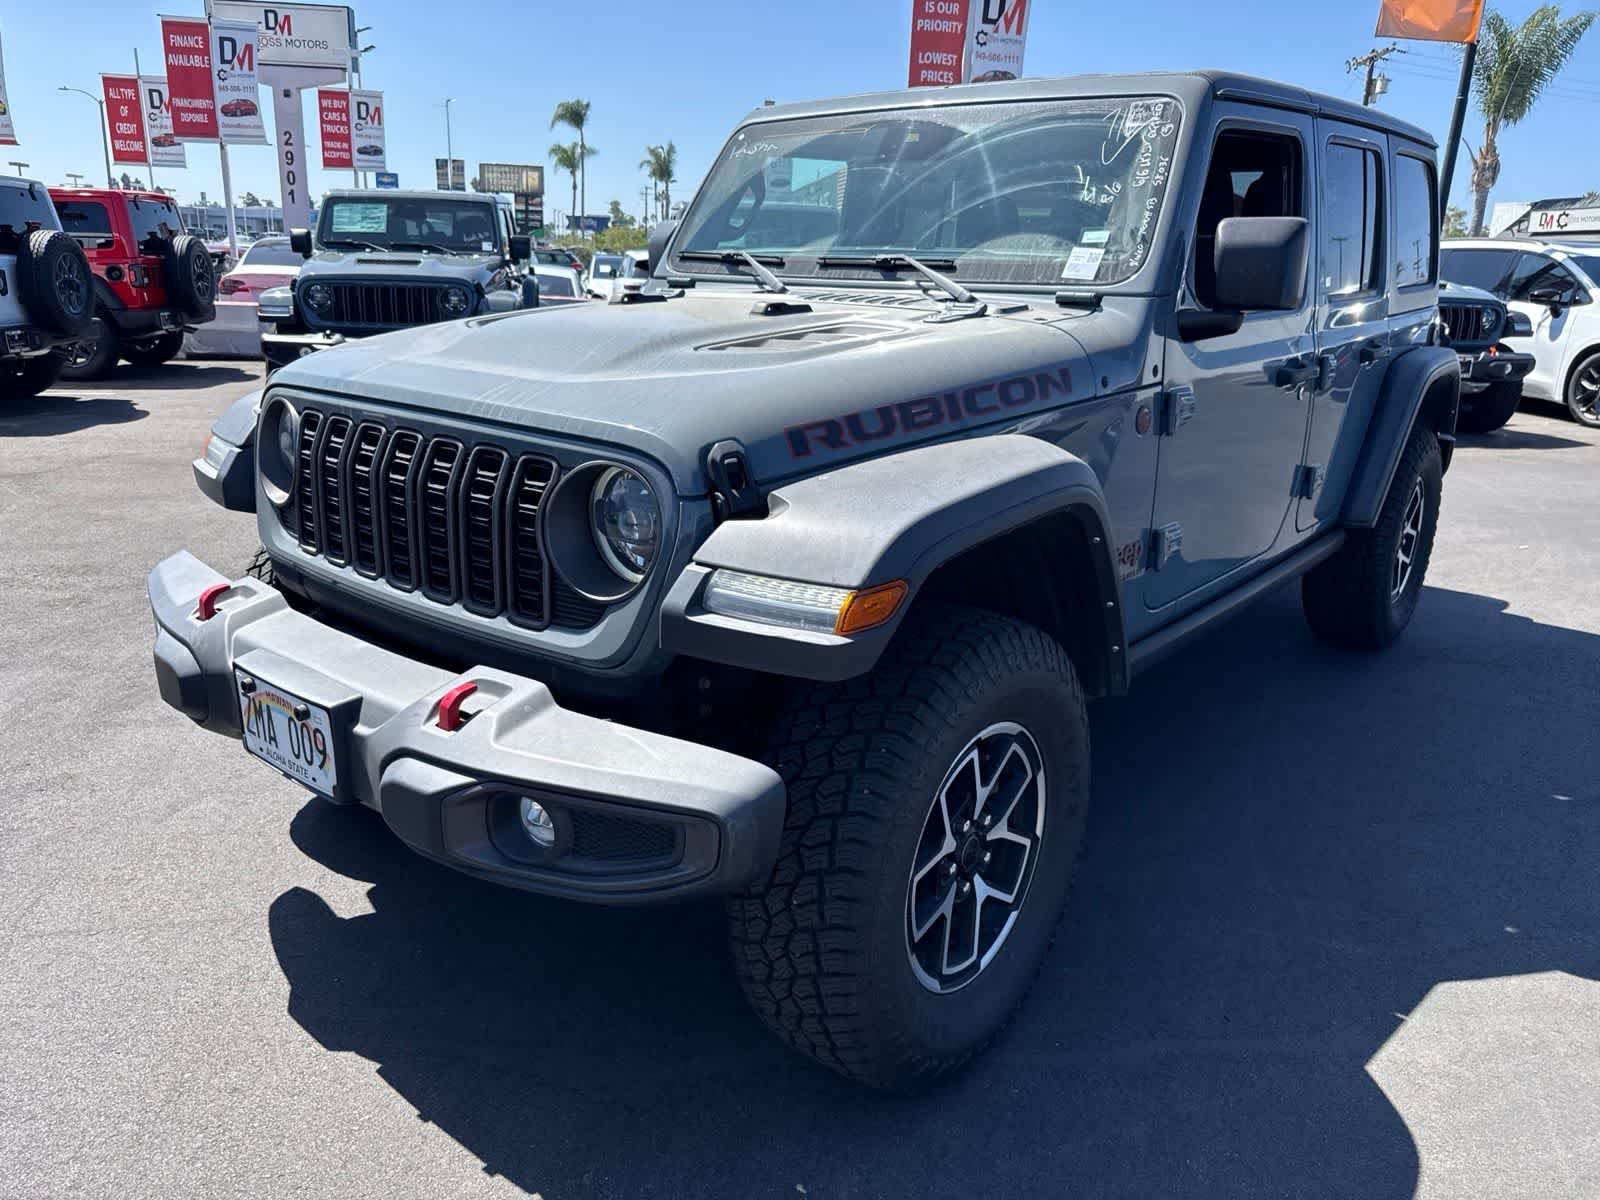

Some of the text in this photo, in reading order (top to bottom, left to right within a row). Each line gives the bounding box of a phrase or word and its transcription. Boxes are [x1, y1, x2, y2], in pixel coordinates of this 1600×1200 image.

[925, 1, 960, 15] IS OUR
[916, 19, 963, 34] PRIORITY
[169, 35, 204, 48] FINANCE
[285, 38, 329, 50] MOTORS
[168, 54, 210, 68] AVAILABLE
[918, 52, 958, 67] LOWEST
[920, 70, 954, 84] PRICES
[109, 87, 136, 100] ALL TYPE
[321, 99, 347, 109] WE BUY
[120, 105, 129, 117] OF
[322, 112, 347, 122] CARS &
[115, 122, 137, 134] CREDIT
[322, 124, 349, 134] TRUCKS
[113, 140, 145, 153] WELCOME
[283, 130, 296, 205] 2901
[783, 367, 1073, 460] RUBICON
[288, 716, 327, 771] 009
[266, 747, 310, 779] ALOHA STATE
